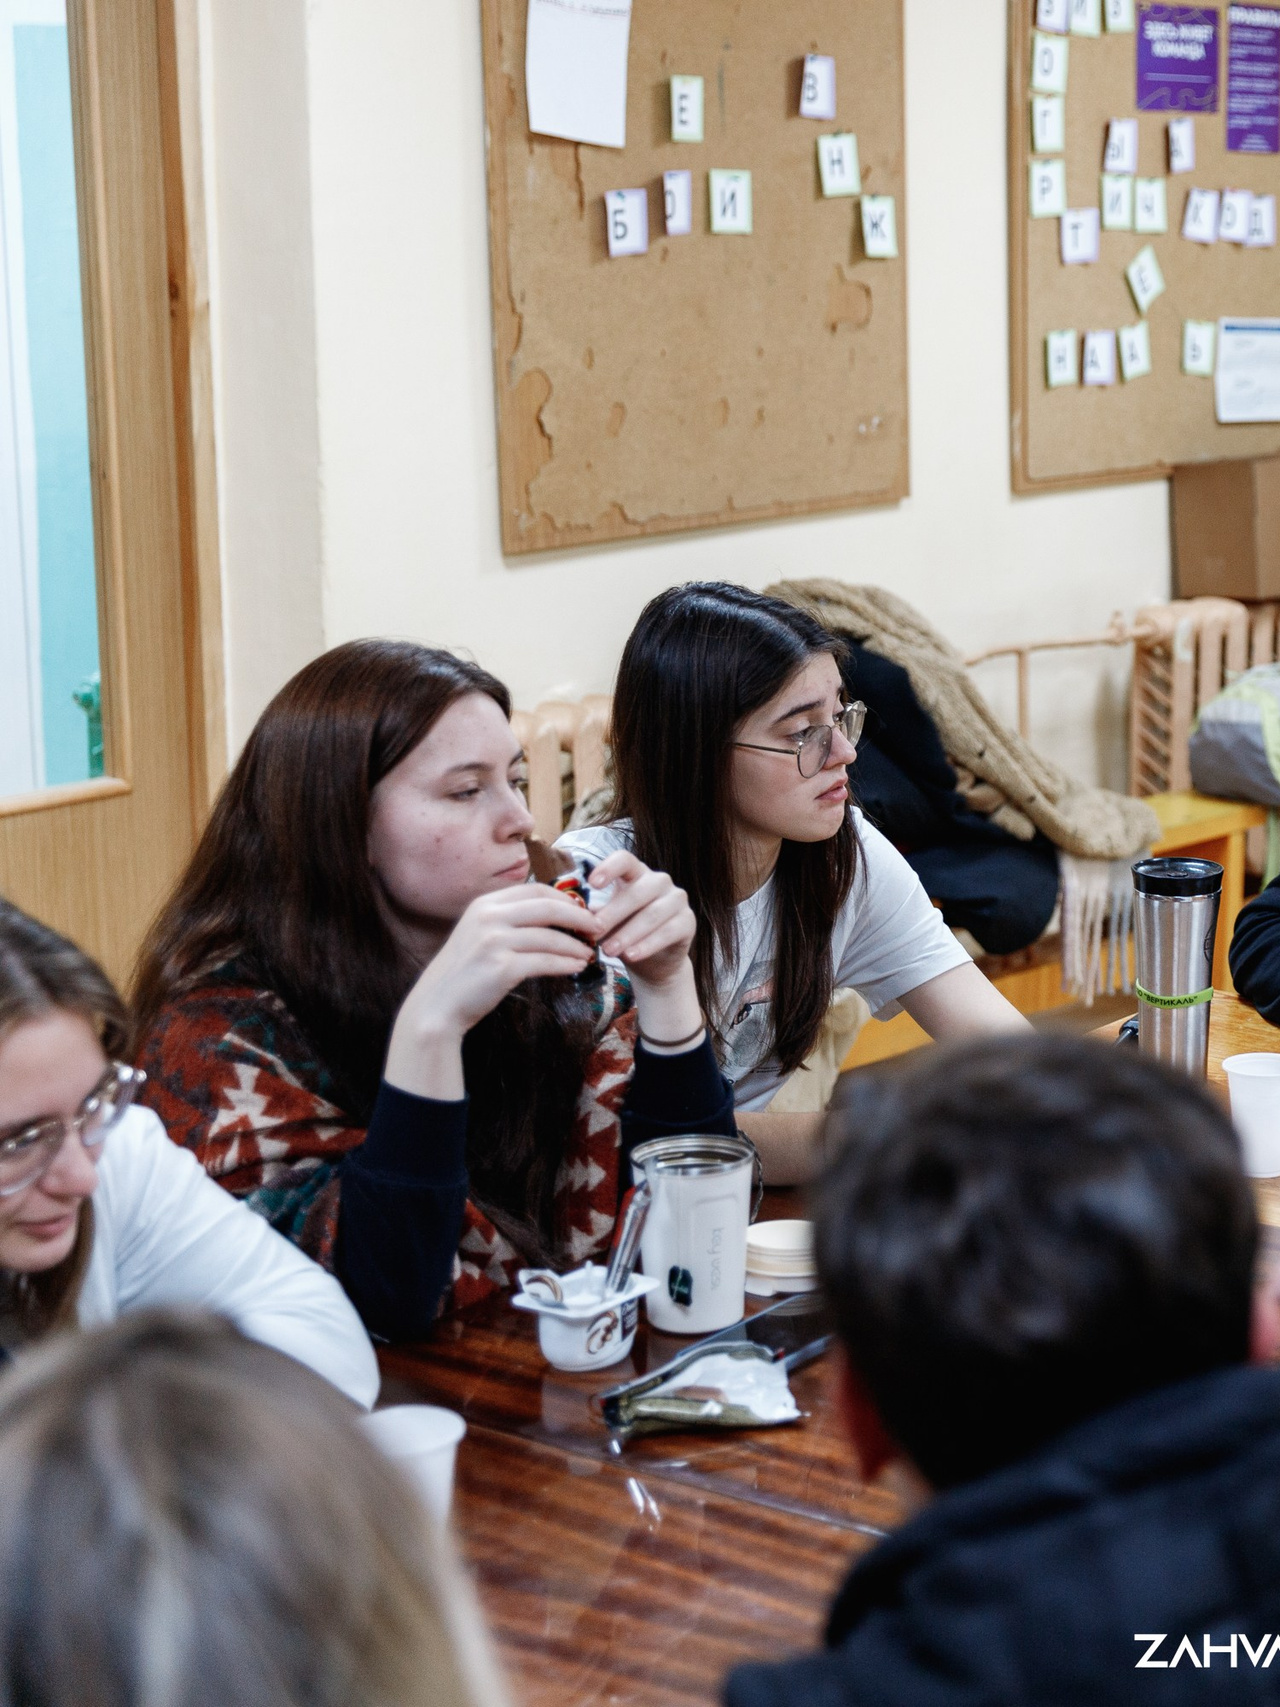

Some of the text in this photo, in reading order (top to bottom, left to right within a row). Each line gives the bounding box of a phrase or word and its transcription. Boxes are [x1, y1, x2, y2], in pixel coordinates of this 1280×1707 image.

[678, 93, 690, 126] Е
[828, 146, 846, 177] Н
[612, 208, 629, 241] Б
